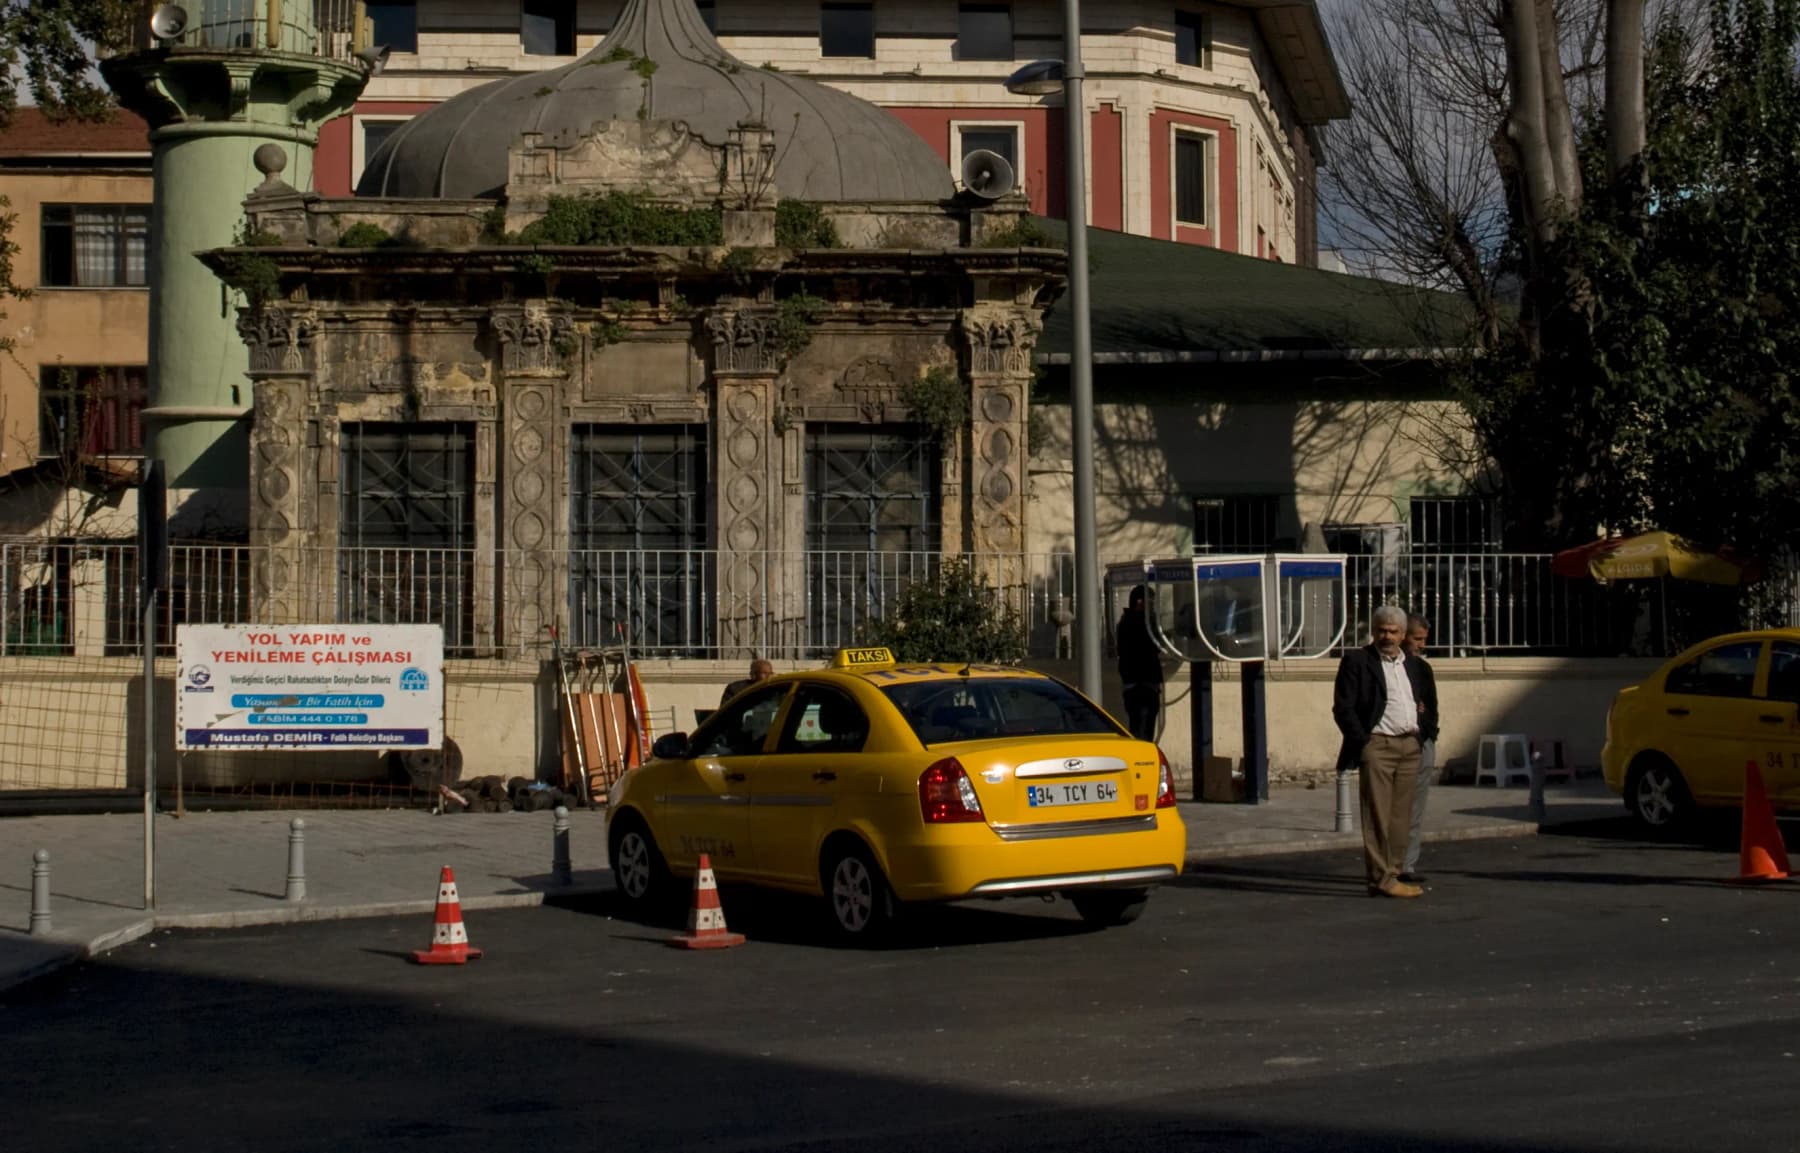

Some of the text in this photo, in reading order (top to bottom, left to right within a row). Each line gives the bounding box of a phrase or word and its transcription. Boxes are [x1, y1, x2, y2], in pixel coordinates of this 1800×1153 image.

[247, 633, 372, 645] YOL YAPIM ve
[211, 649, 412, 666] YENİLEME ÇALIŞMASI
[848, 650, 889, 663] TAKSİ
[325, 696, 352, 706] Fatih
[300, 715, 321, 723] 444
[210, 733, 269, 742] Mustafa
[1036, 787, 1054, 804] 34
[1063, 785, 1087, 802] TCY
[1096, 783, 1113, 800] 64
